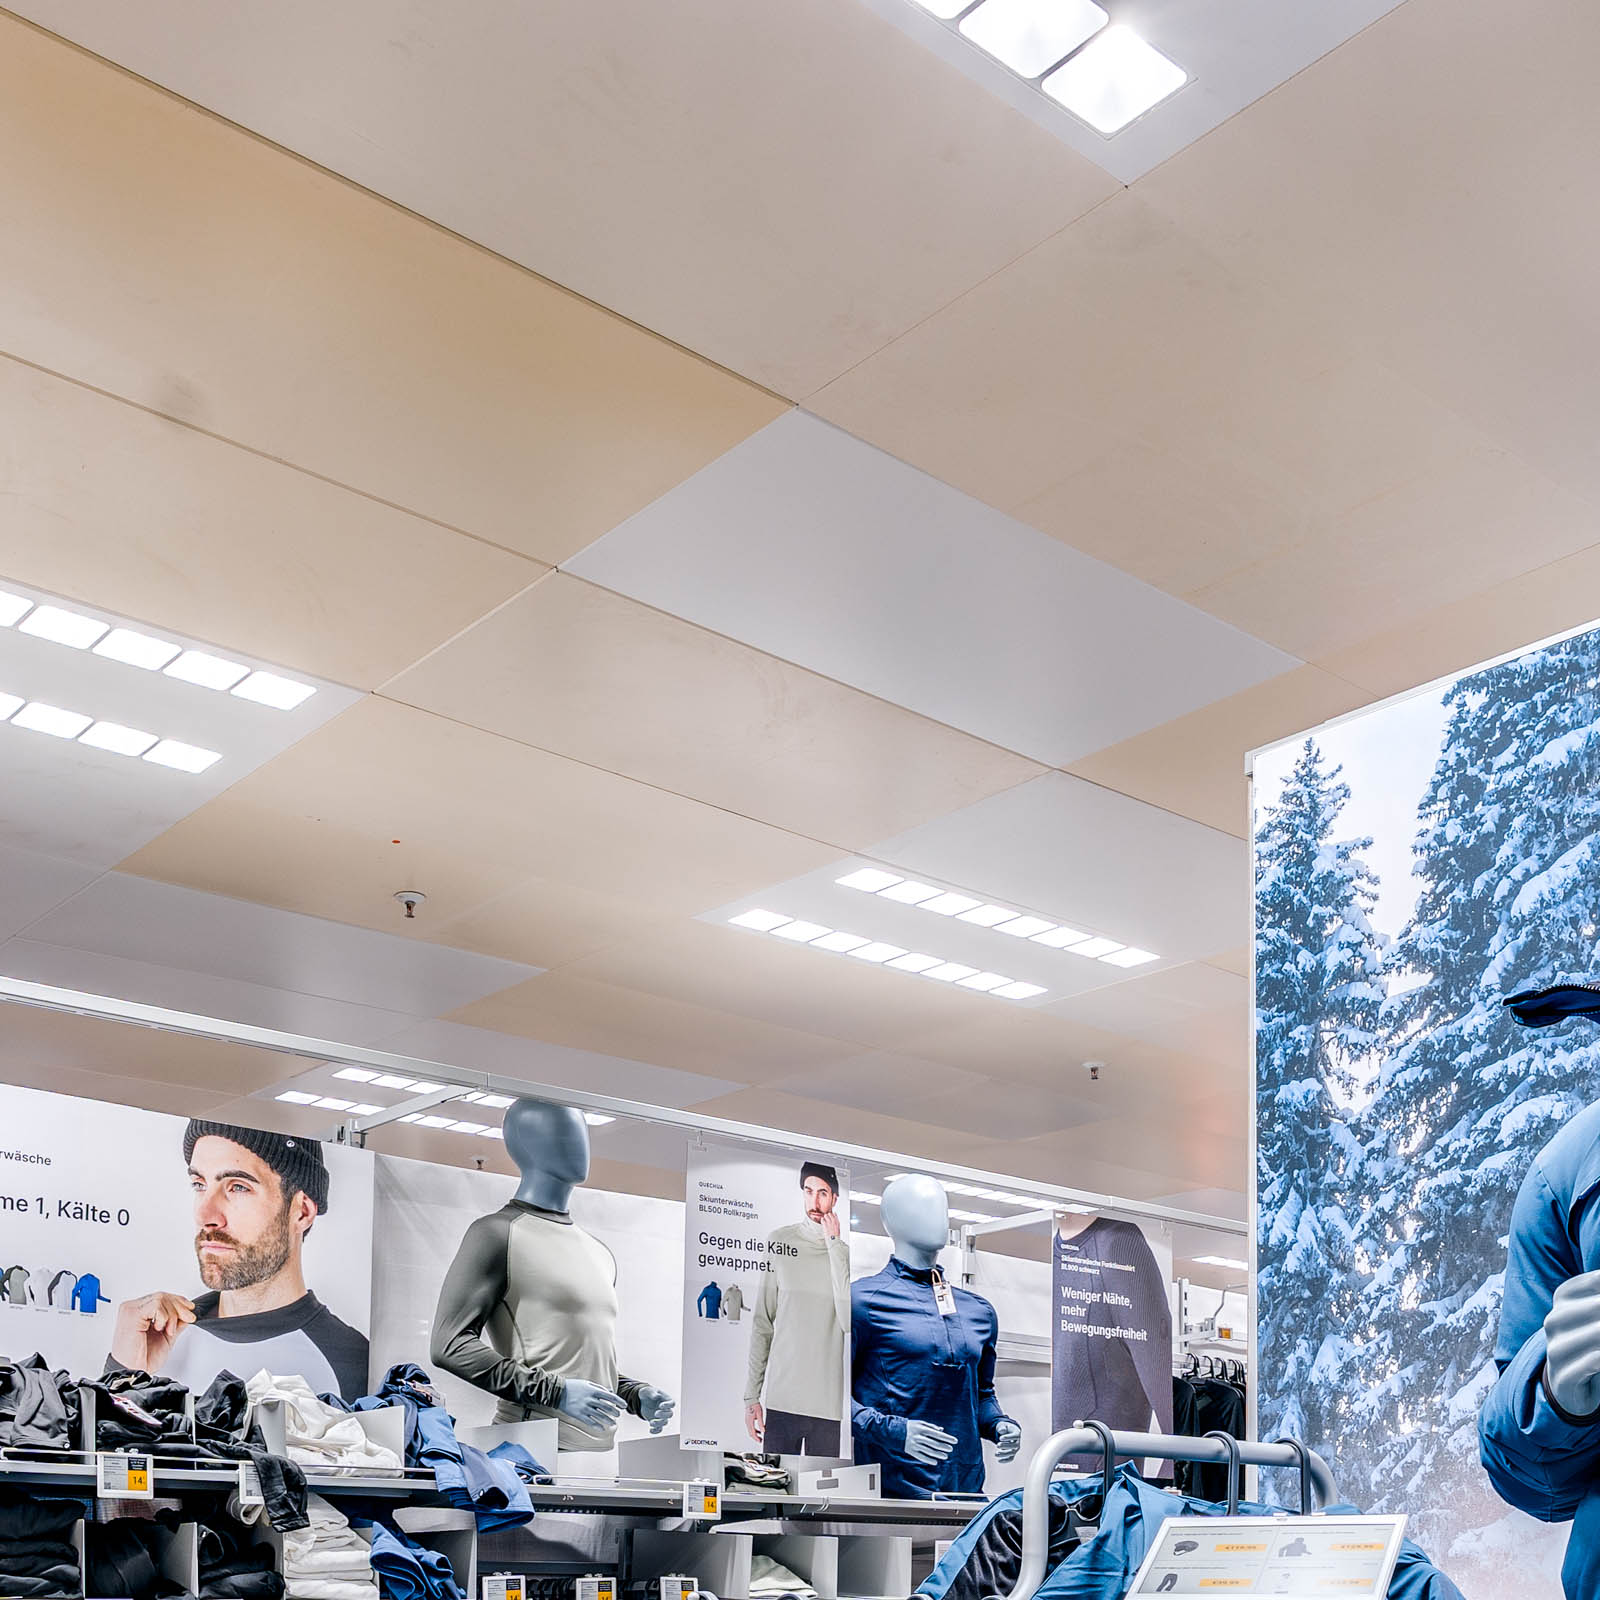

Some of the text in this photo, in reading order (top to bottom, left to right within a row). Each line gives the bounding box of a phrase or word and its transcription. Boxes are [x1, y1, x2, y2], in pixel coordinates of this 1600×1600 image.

[699, 1181, 723, 1190] QUECHUA
[699, 1194, 754, 1209] Skiunterwäsche
[35, 1197, 50, 1219] 1,
[57, 1199, 111, 1224] Kälte
[117, 1208, 130, 1226] 0
[699, 1204, 758, 1220] BL500 Rollkragen
[698, 1231, 798, 1257] Gegen die Kälte
[698, 1254, 775, 1273] gewappnet.
[1061, 1286, 1133, 1309] Weniger Nähte,
[1061, 1304, 1087, 1317] mehr
[1061, 1319, 1148, 1342] Bewegungsfreiheit
[133, 1476, 143, 1485] 14
